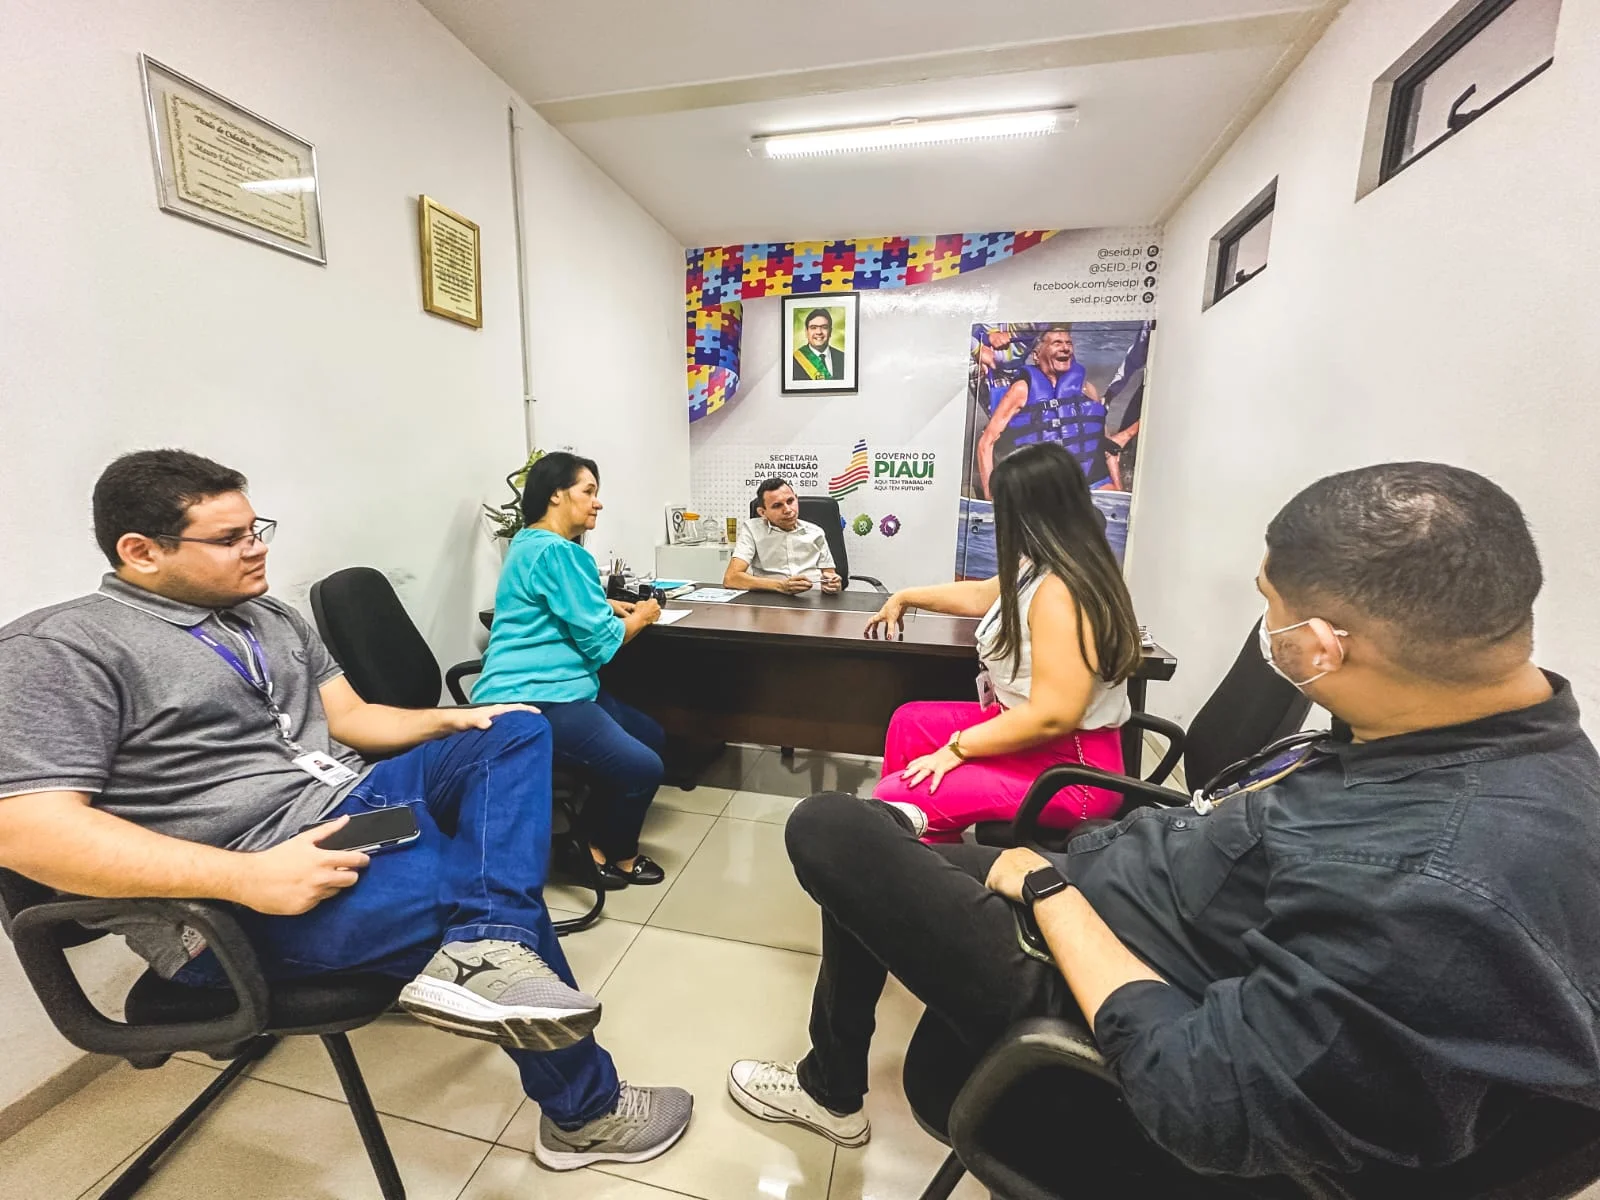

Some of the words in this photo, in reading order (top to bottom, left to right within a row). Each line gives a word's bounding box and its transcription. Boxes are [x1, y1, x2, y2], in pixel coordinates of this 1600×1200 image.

[1097, 247, 1143, 259] @seid.pi
[1089, 262, 1141, 274] @SEID_PI
[1033, 278, 1139, 291] facebook.com/seidpi
[1070, 294, 1138, 304] seid.pi.gov.br
[769, 454, 818, 462] SECRETARIA
[874, 452, 919, 460] GOVERNO
[921, 452, 936, 460] DO
[777, 461, 818, 470] INCLUSÃO
[874, 460, 935, 478] PIAUÍ
[799, 471, 818, 479] COM
[800, 479, 818, 487] SEID
